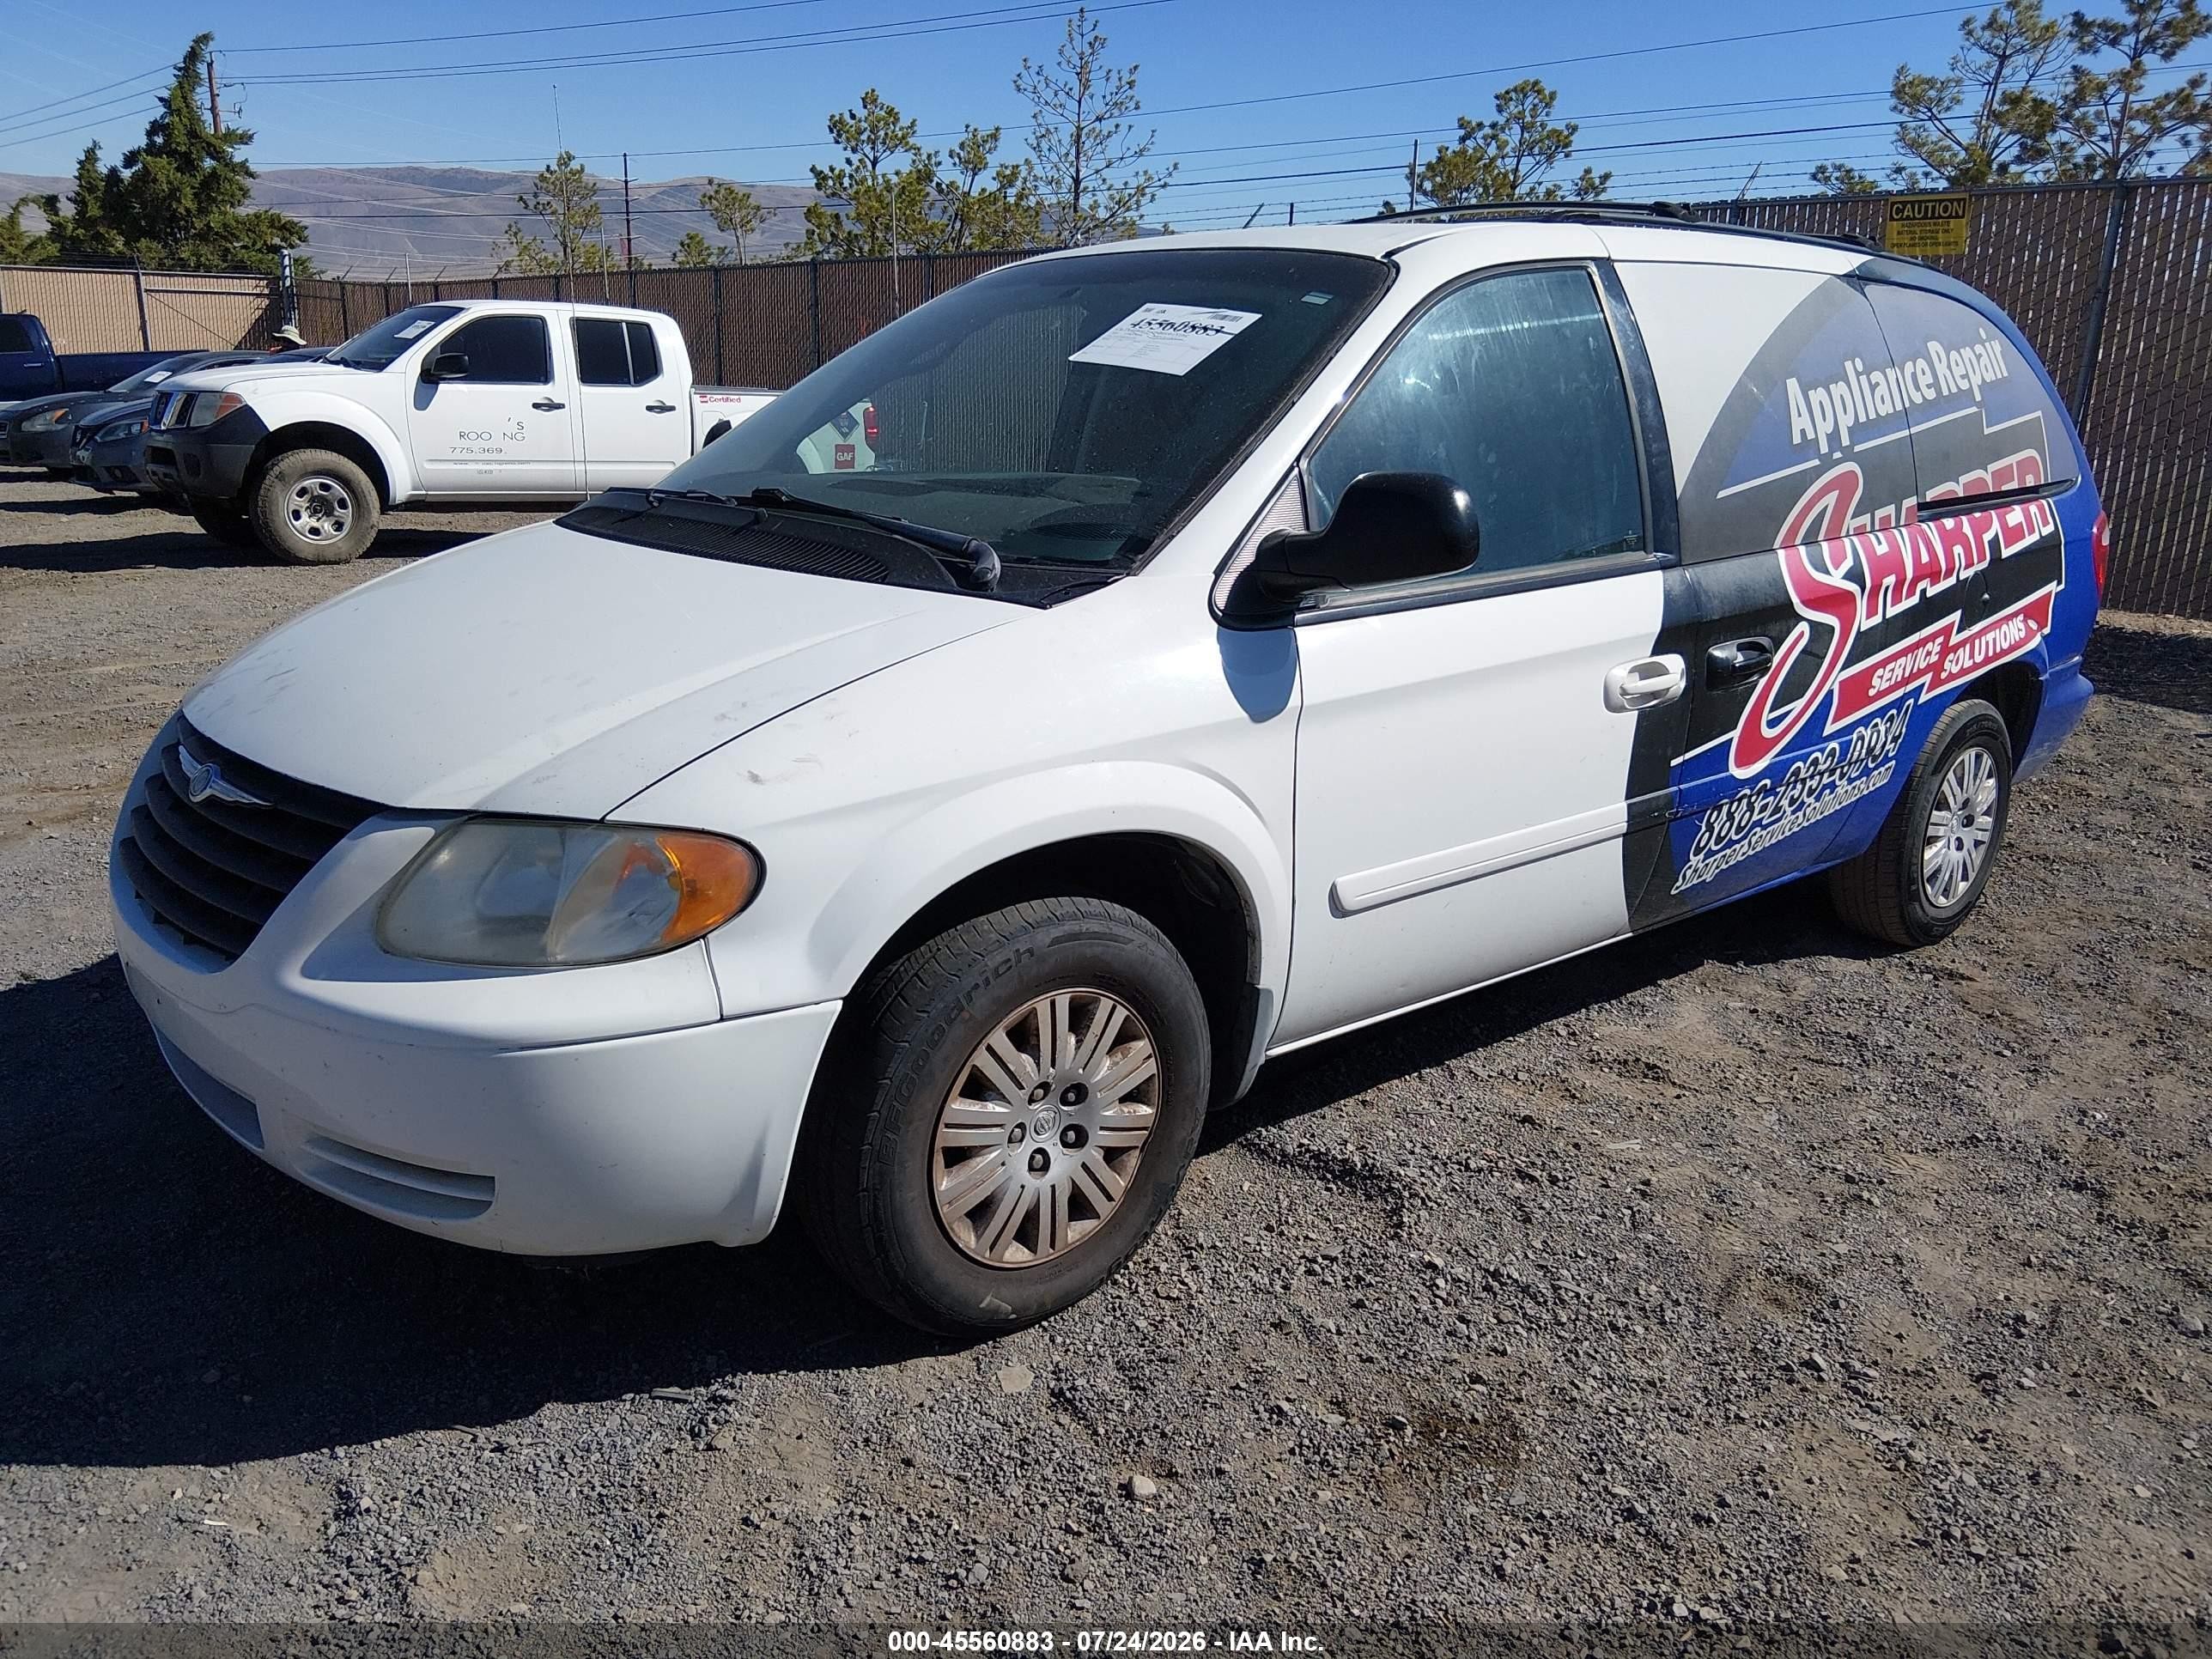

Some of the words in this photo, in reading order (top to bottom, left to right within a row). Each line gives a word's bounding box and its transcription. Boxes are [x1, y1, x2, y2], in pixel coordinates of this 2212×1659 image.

[1892, 201, 1964, 219] CAUTION
[1785, 356, 1934, 455] Appliance
[1926, 329, 2008, 402] Repair
[836, 453, 854, 461] GAF
[1729, 449, 2054, 780] SHARPER
[1868, 635, 1944, 697] SERVICE
[1941, 613, 2026, 679] SOLUTIONS
[1670, 760, 1896, 896] SharperServiceSolutions.com
